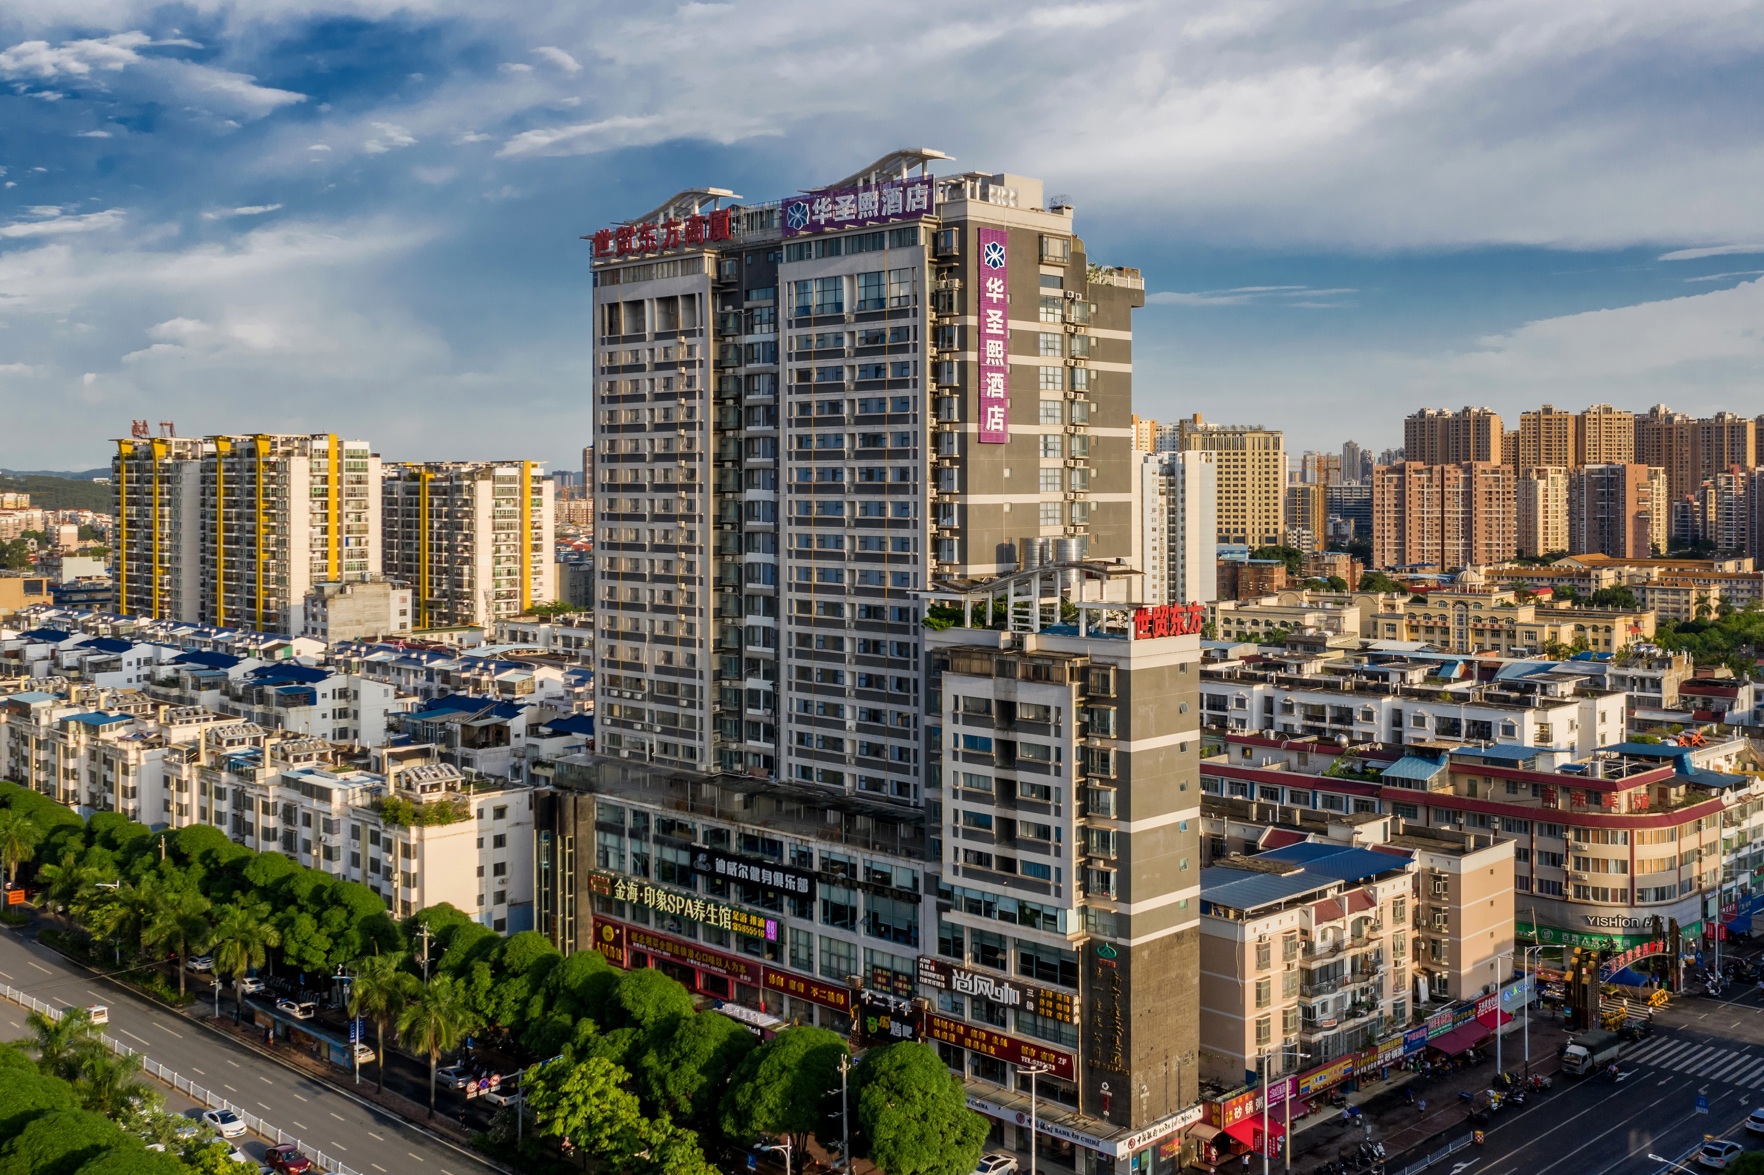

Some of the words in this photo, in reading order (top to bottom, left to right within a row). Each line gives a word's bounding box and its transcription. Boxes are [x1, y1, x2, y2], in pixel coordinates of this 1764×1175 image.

[812, 183, 929, 225] 华圣熙酒店
[986, 277, 1005, 431] 华圣熙酒店
[1133, 601, 1204, 640] 世贸东方
[715, 857, 809, 893] 迪威尔健身俱乐部
[614, 879, 732, 930] 金海·印象SPA养生馆
[952, 969, 1020, 1005] 尚网咖
[1234, 1096, 1264, 1119] 砂锅粥
[1055, 1128, 1071, 1137] BANK
[1081, 1136, 1100, 1147] CHINA
